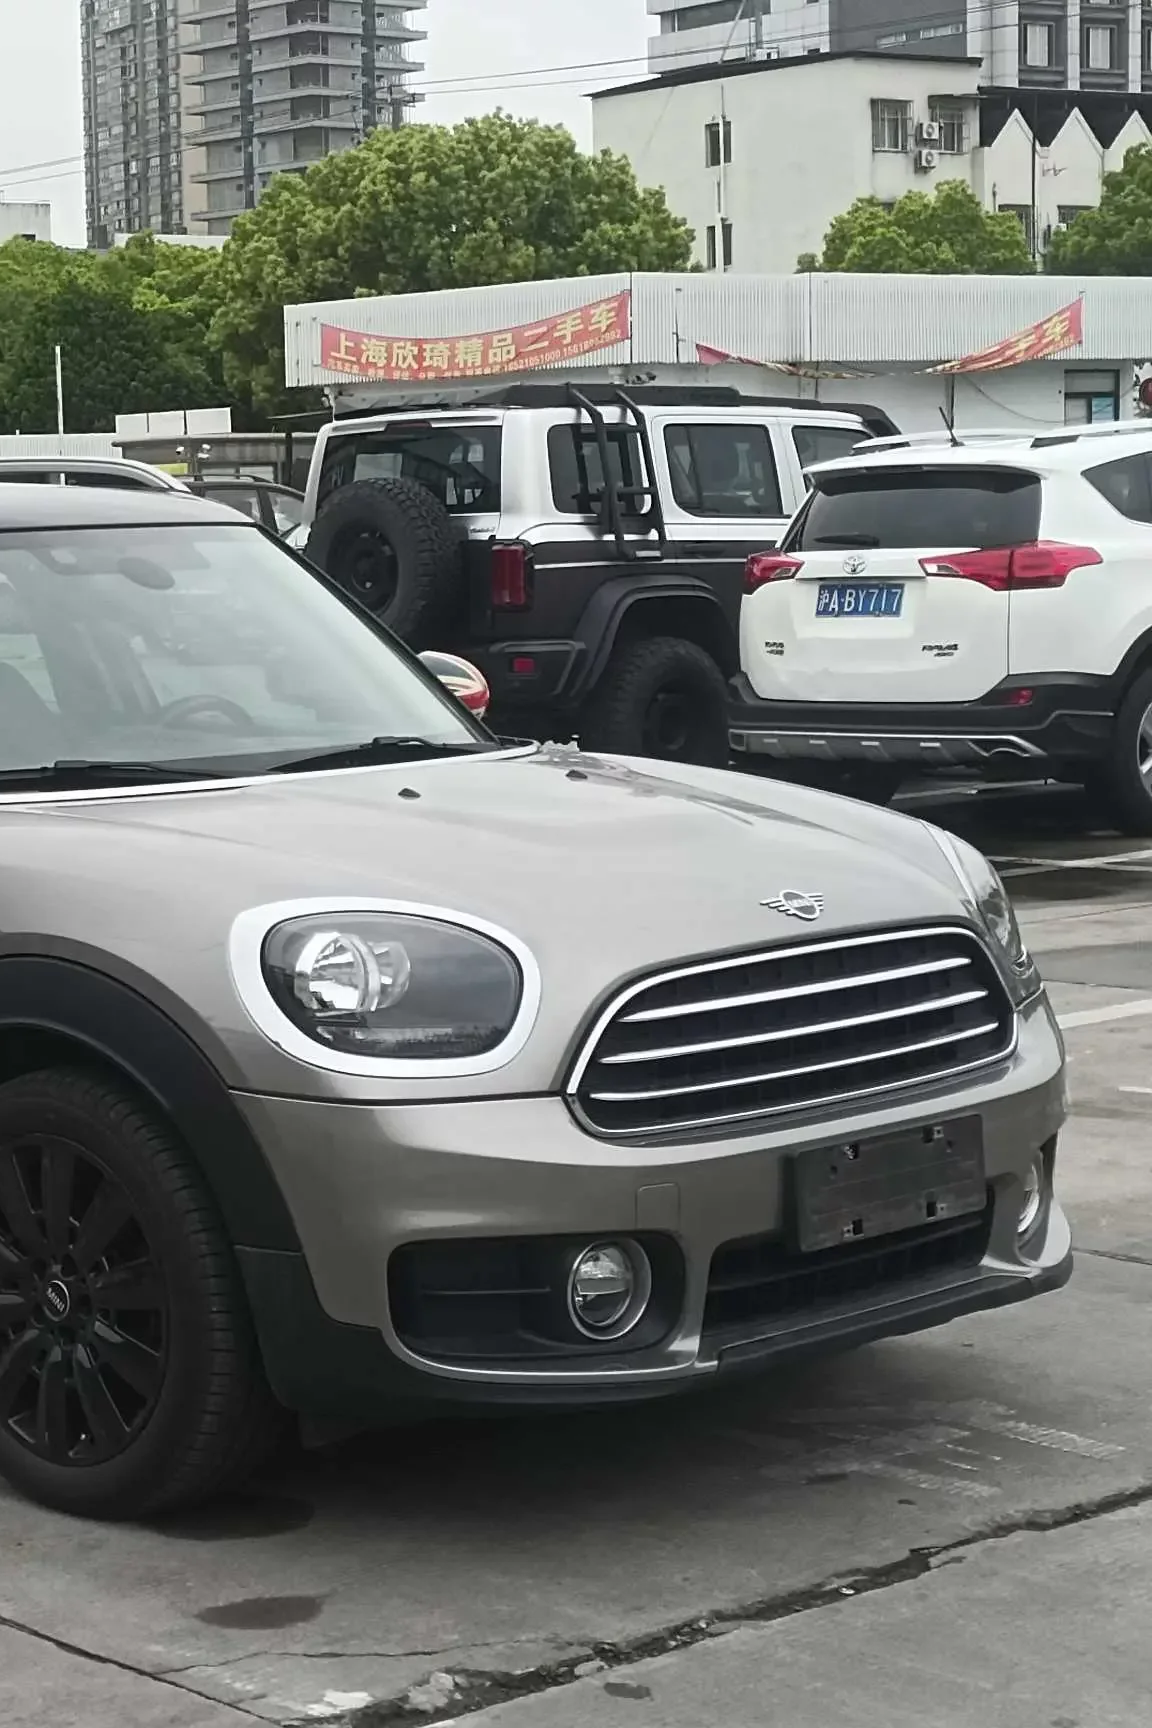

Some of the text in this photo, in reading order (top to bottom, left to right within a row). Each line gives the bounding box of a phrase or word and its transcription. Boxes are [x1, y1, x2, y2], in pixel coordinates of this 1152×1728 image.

[330, 302, 618, 369] 上海欣琦精品二手车
